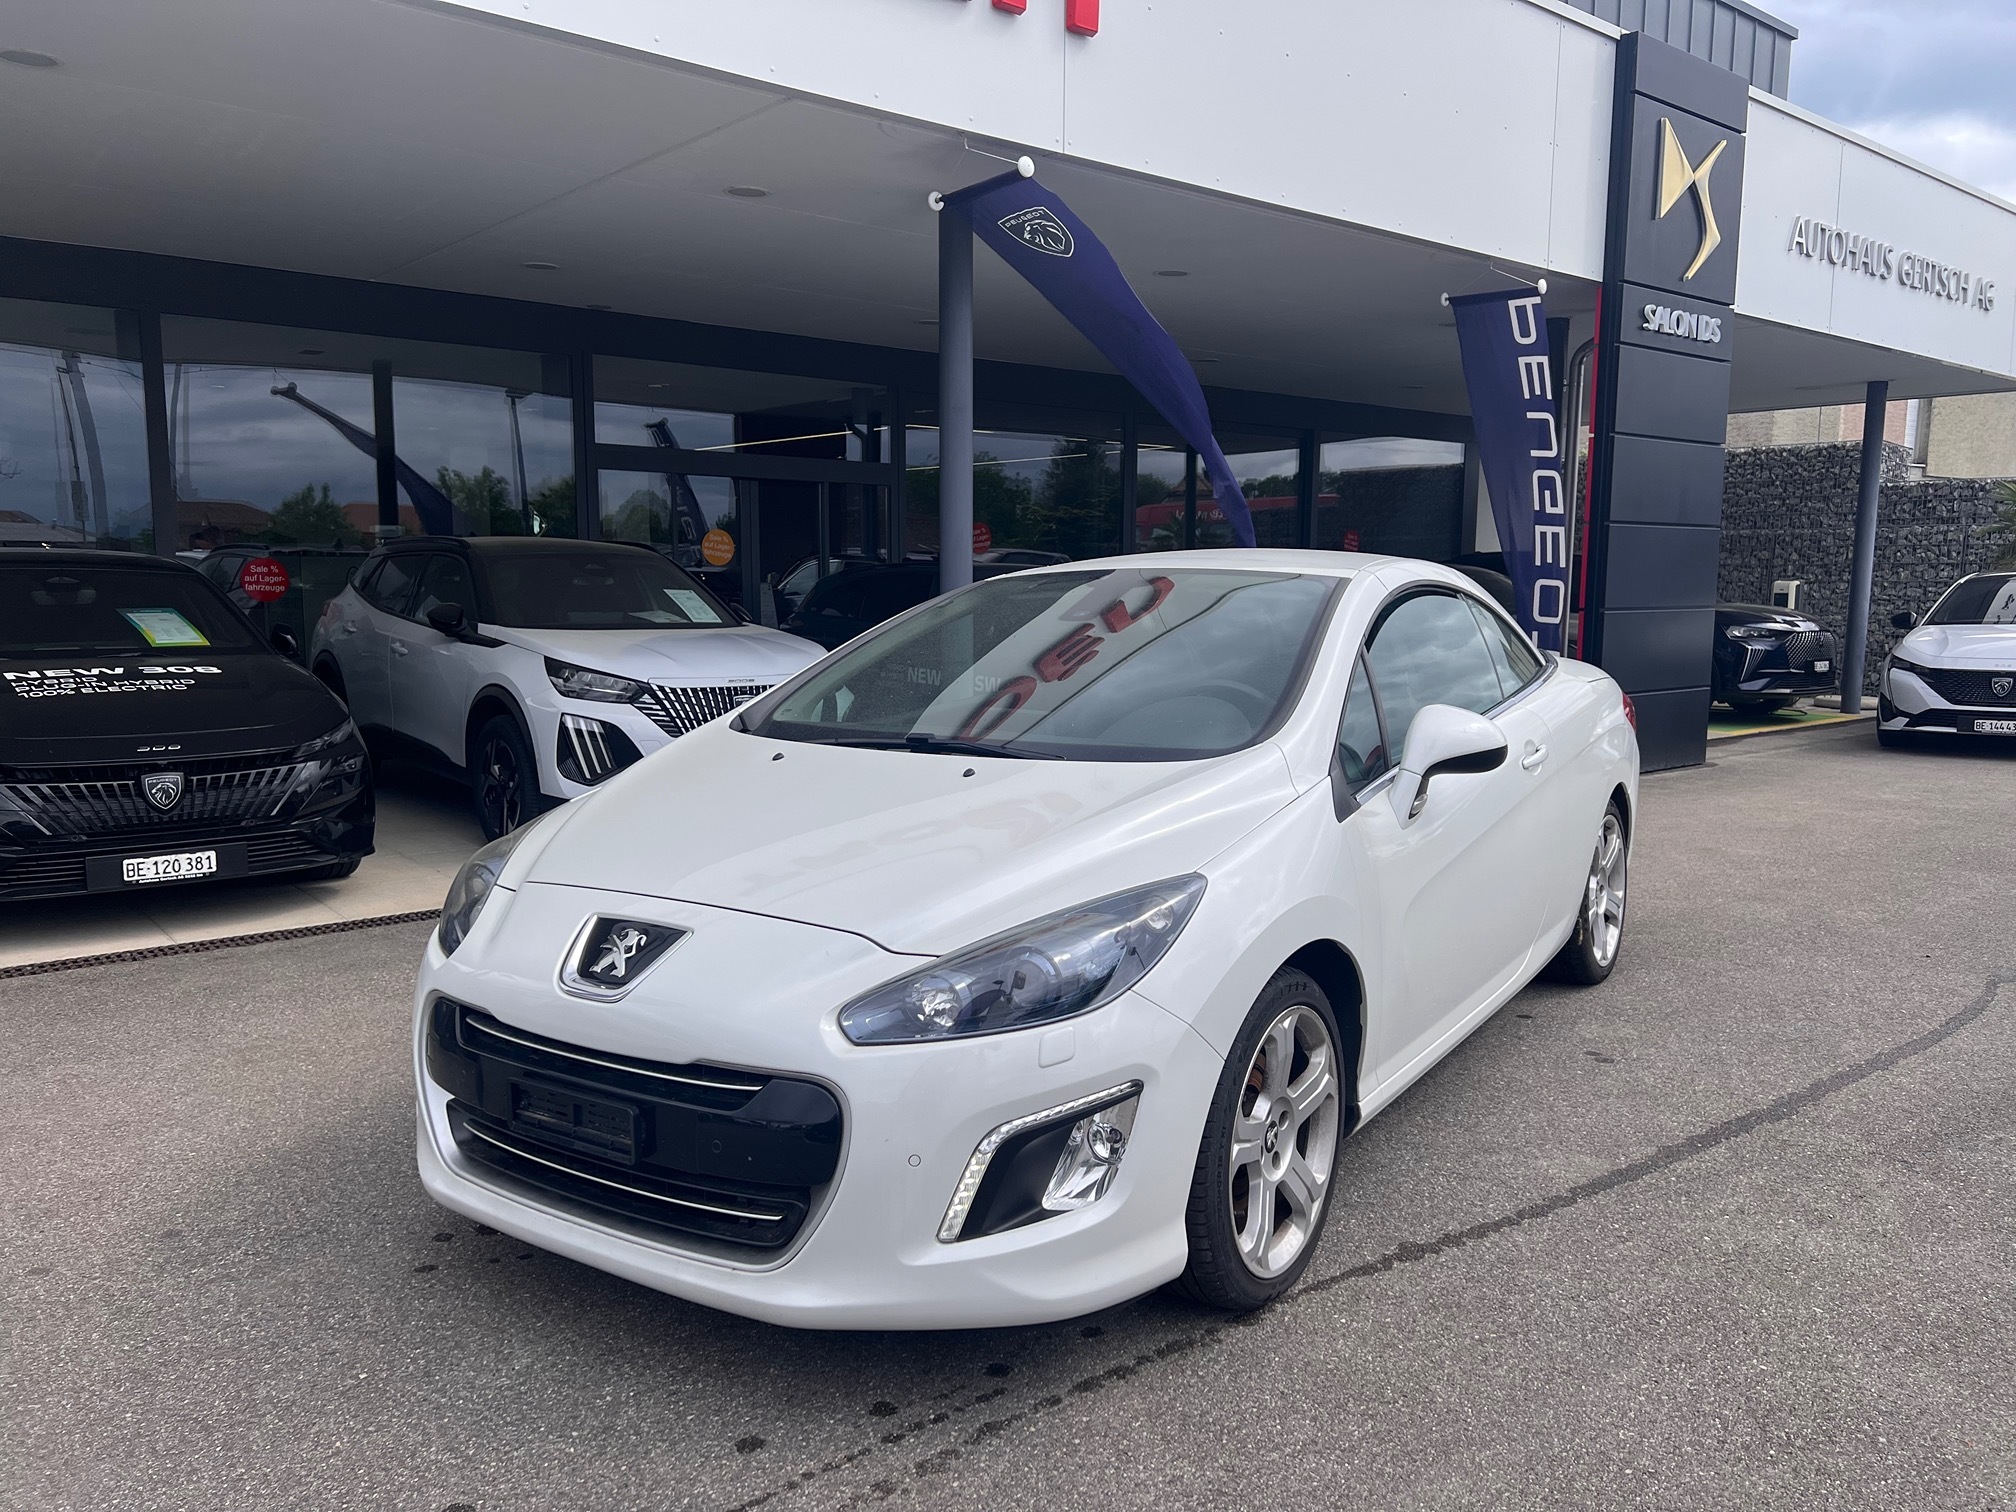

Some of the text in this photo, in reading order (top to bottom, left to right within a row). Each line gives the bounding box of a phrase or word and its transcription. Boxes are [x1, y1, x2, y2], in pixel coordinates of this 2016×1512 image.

[1004, 210, 1045, 228] PEUGEOT
[1788, 215, 1997, 312] AUTOHAUS GERTSCH AG
[1642, 304, 1722, 343] SALON DS
[250, 565, 268, 573] Sale
[259, 575, 285, 583] Lager-
[245, 584, 285, 592] fahrzeuge
[2, 666, 223, 680] NEW 308
[907, 666, 942, 687] NEW
[10, 676, 98, 687] HYBRID
[14, 681, 109, 693] PLUG-IN
[17, 684, 188, 698] 100% ELECTRIC
